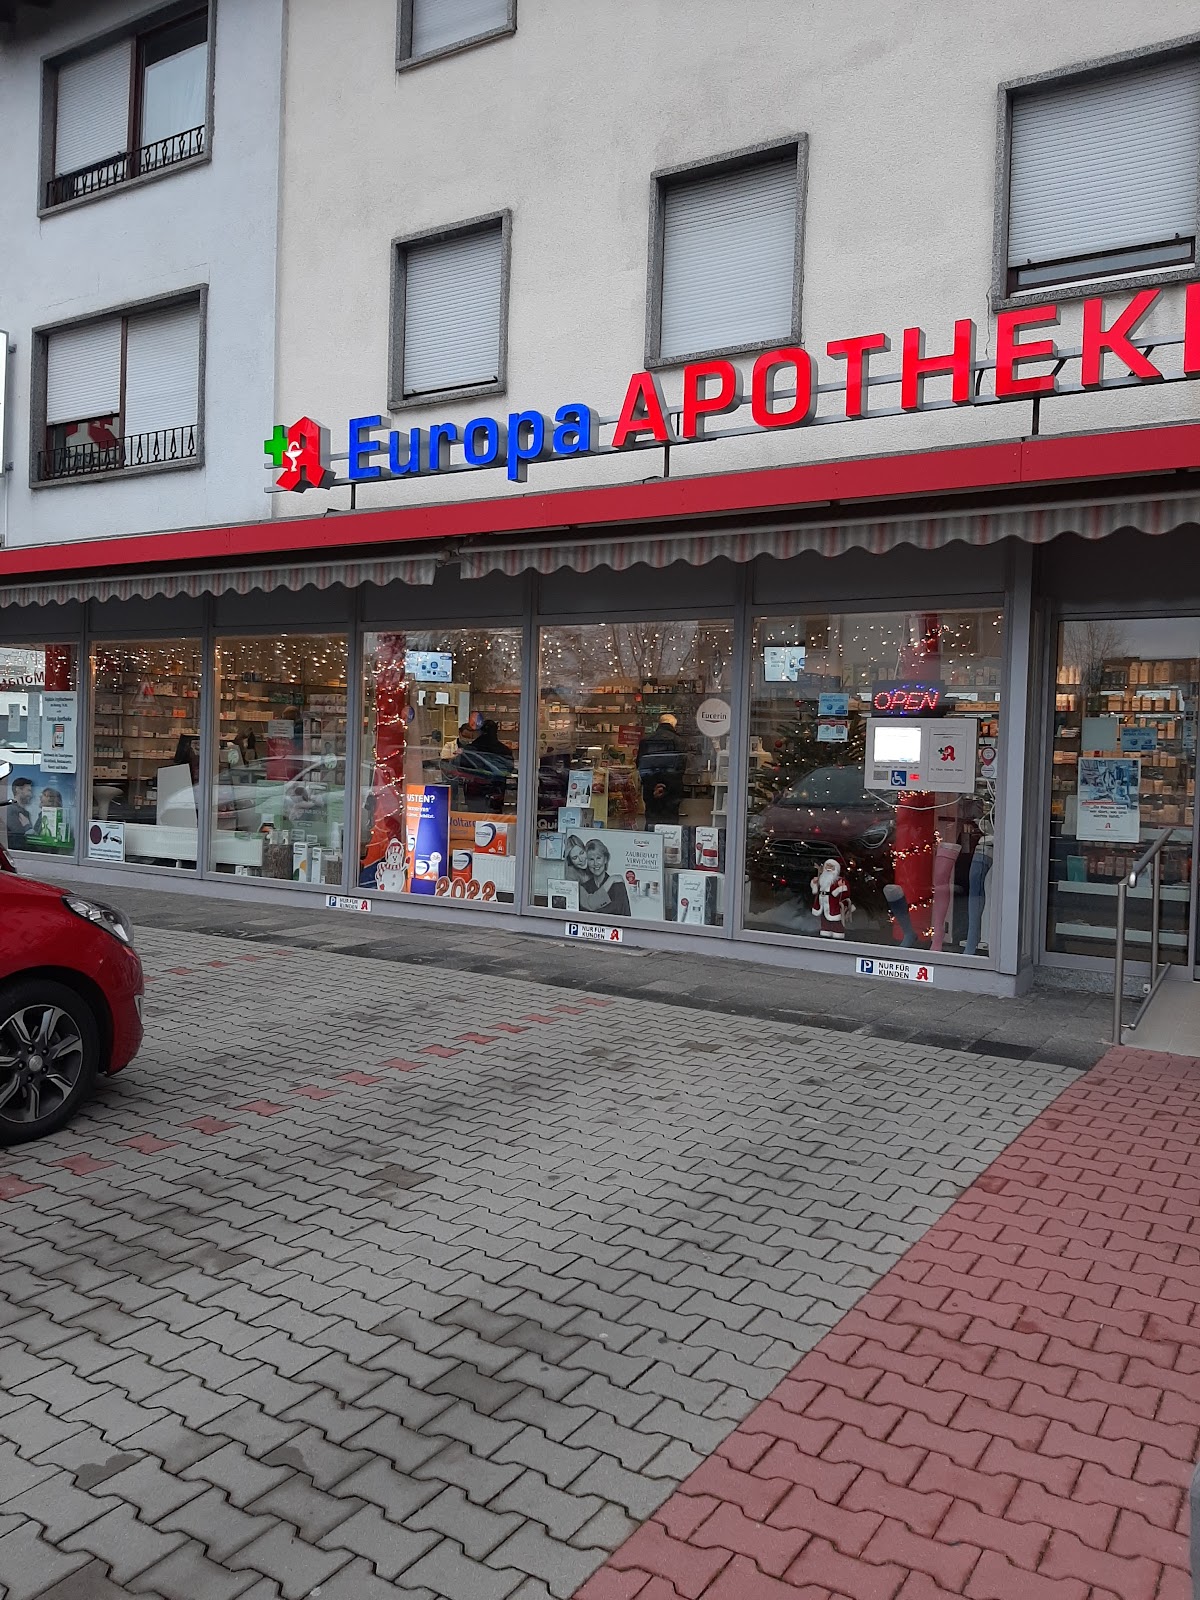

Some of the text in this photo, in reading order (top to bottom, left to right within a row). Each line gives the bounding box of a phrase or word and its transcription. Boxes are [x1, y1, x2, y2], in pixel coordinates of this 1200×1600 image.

[349, 403, 590, 482] Europa
[612, 283, 1200, 449] APOTHEK
[874, 691, 939, 710] OPEN
[701, 711, 727, 720] Eucerin
[436, 876, 497, 902] 2022
[879, 962, 893, 970] NUR
[895, 964, 910, 972] FÜR
[879, 969, 909, 979] KUNDEN
